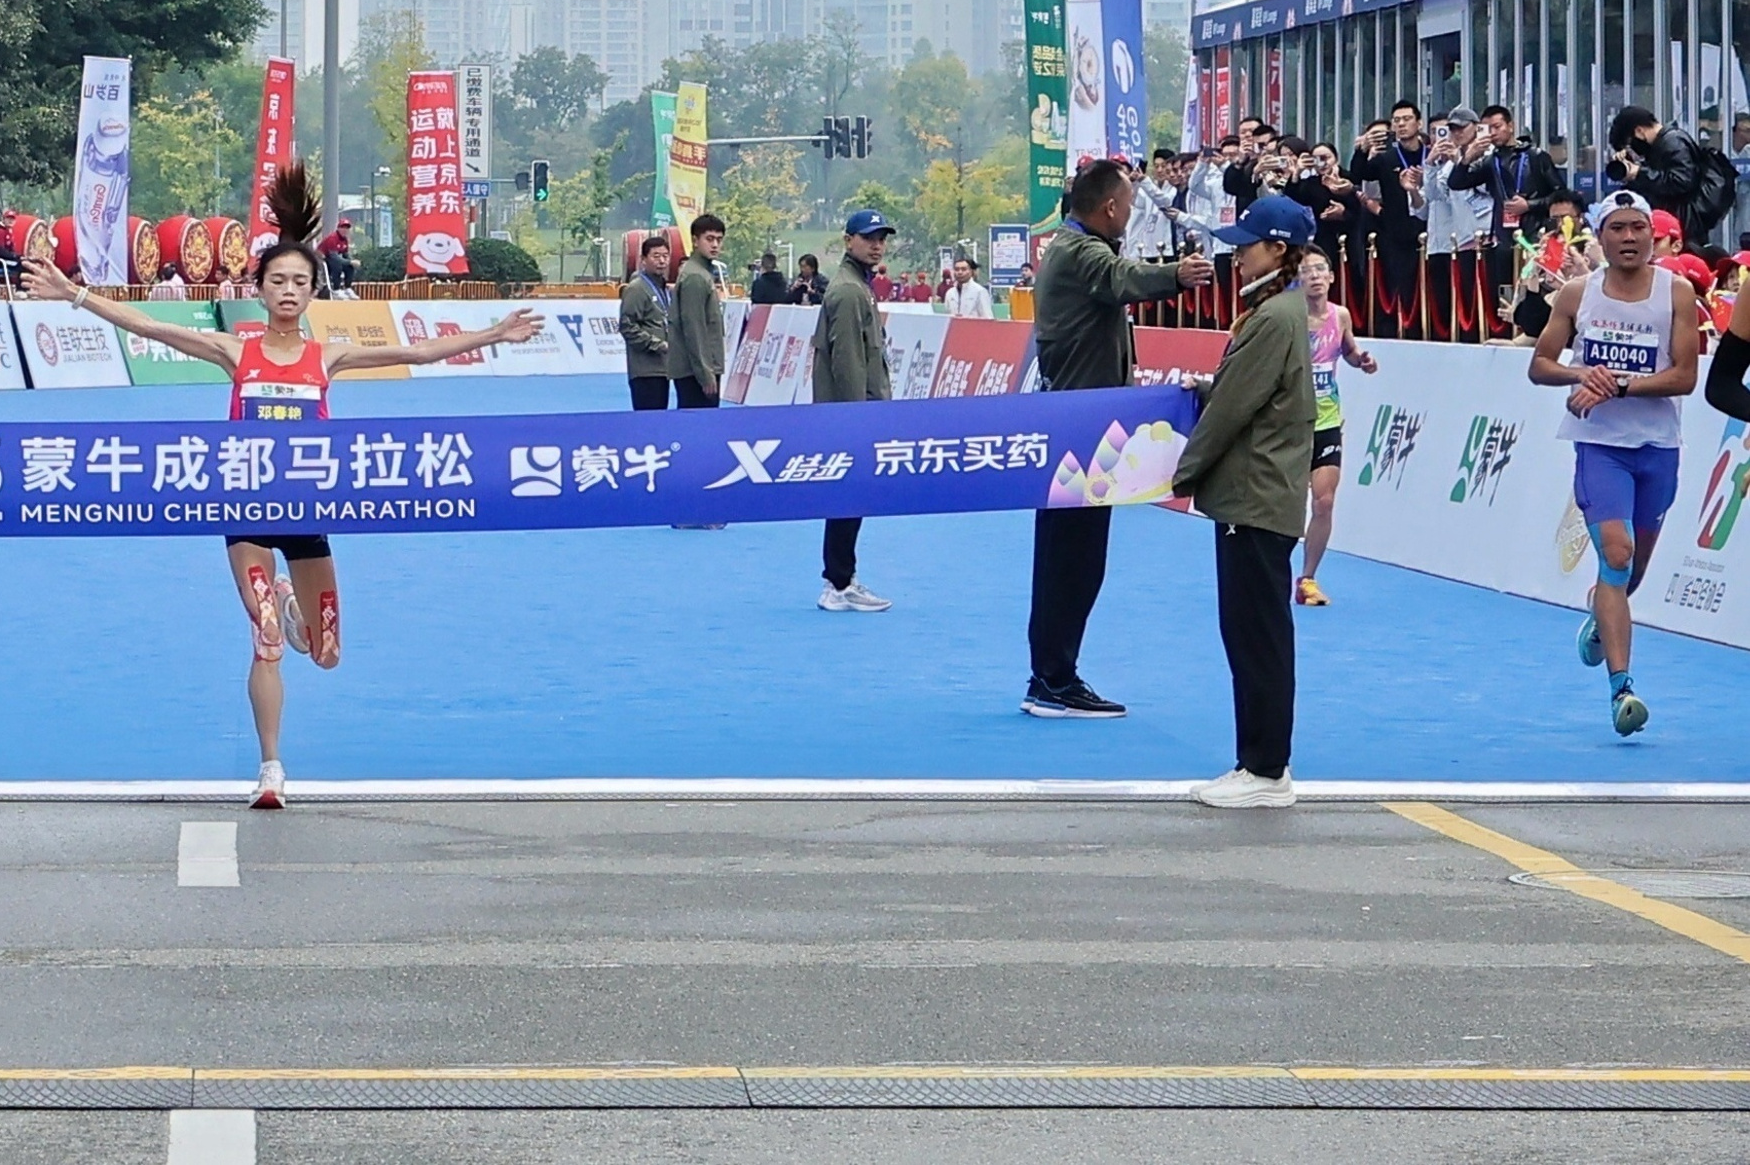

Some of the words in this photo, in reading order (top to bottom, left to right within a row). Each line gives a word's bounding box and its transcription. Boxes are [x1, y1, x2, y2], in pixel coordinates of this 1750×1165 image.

[465, 67, 483, 158] 已缴费车辆专用通道
[410, 107, 438, 217] 运动营养
[435, 106, 461, 215] 就上京东
[56, 325, 110, 351] 佳联生技
[1589, 343, 1648, 365] A10040
[19, 431, 476, 493] 蒙牛成都马拉松
[571, 443, 672, 493] 蒙牛
[774, 450, 854, 484] 特步
[872, 432, 1049, 477] 京东买药
[1377, 407, 1422, 492] 蒙牛
[1471, 417, 1520, 507] 蒙牛
[20, 503, 154, 524] MENGNIU
[163, 500, 304, 522] CHENGDU
[314, 497, 476, 521] MARATHON
